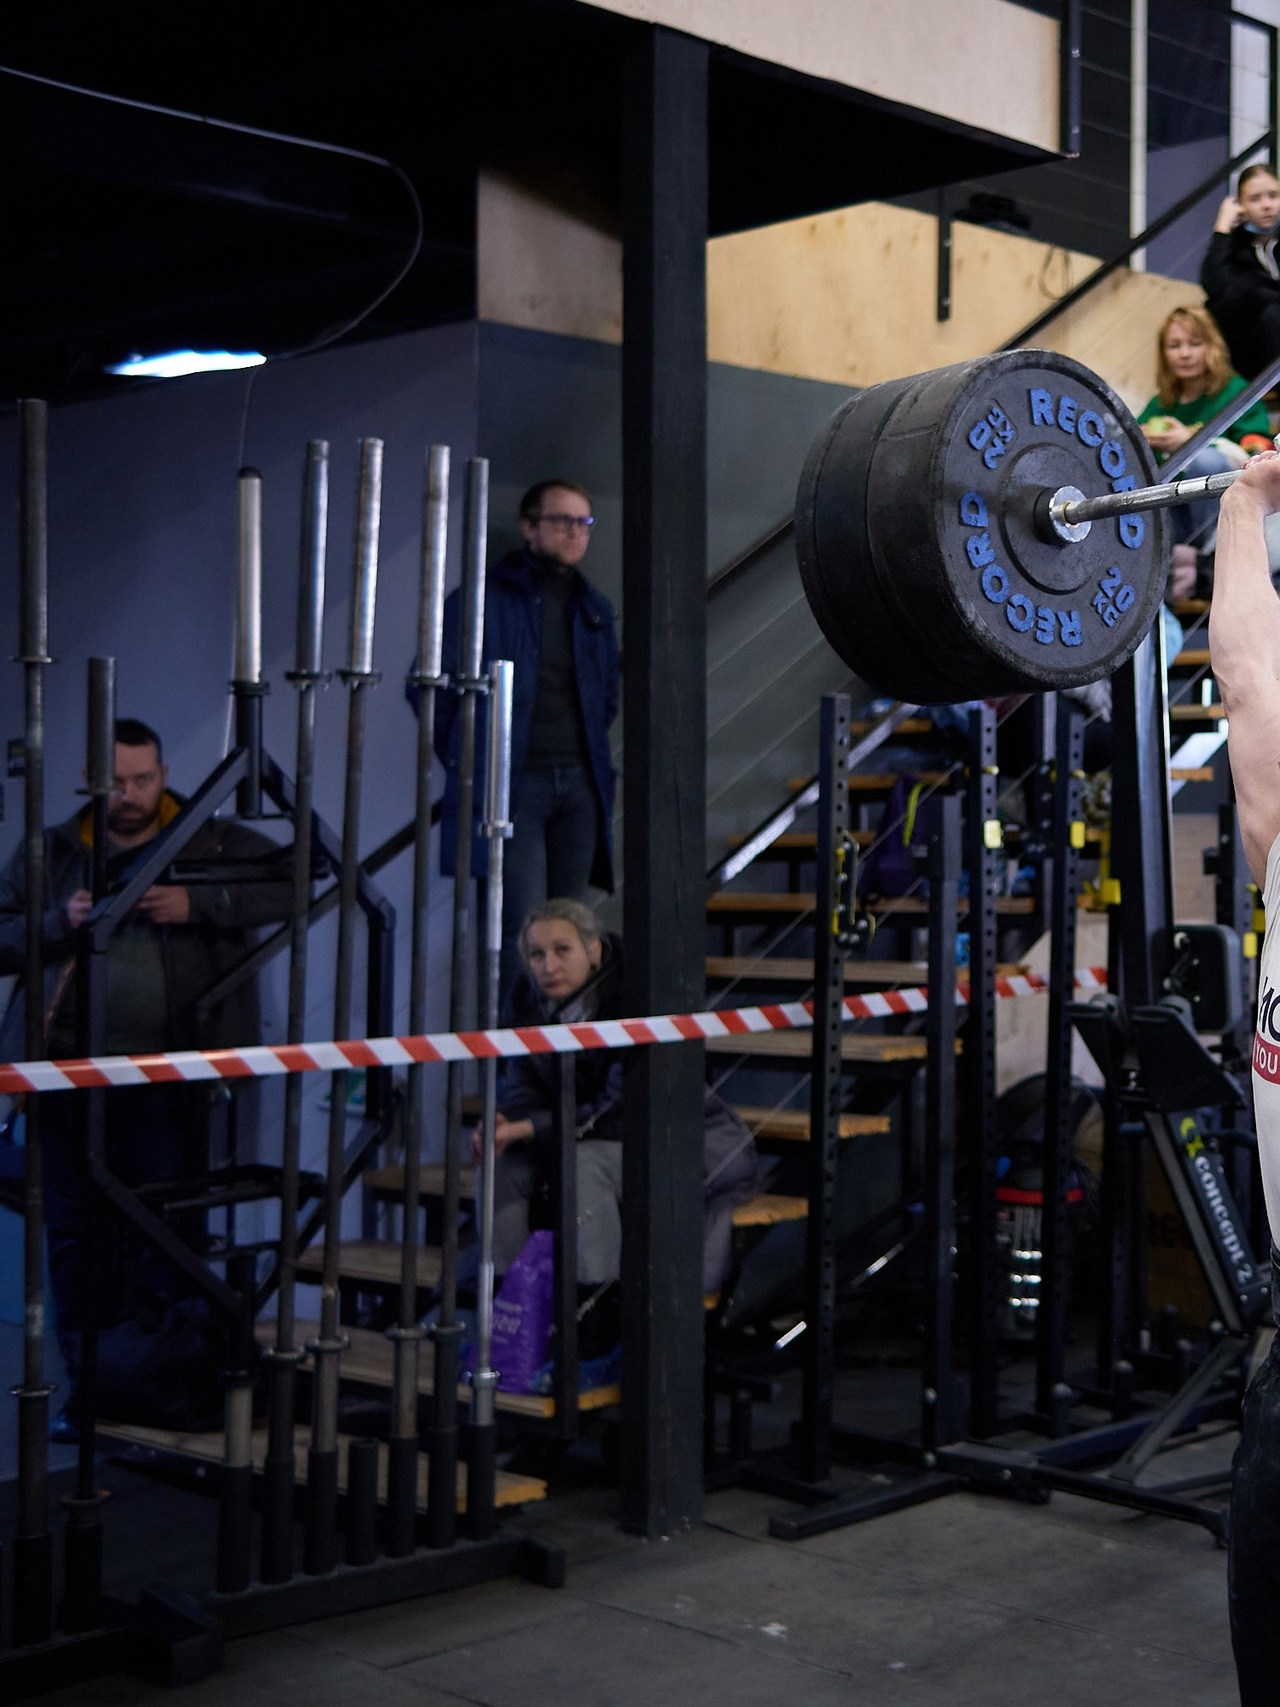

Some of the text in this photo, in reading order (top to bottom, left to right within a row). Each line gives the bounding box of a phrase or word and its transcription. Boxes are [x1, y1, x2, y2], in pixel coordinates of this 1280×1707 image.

[968, 419, 1007, 470] 20
[960, 489, 1084, 648] RECORD
[1100, 565, 1136, 614] 20
[1091, 590, 1123, 629] KG
